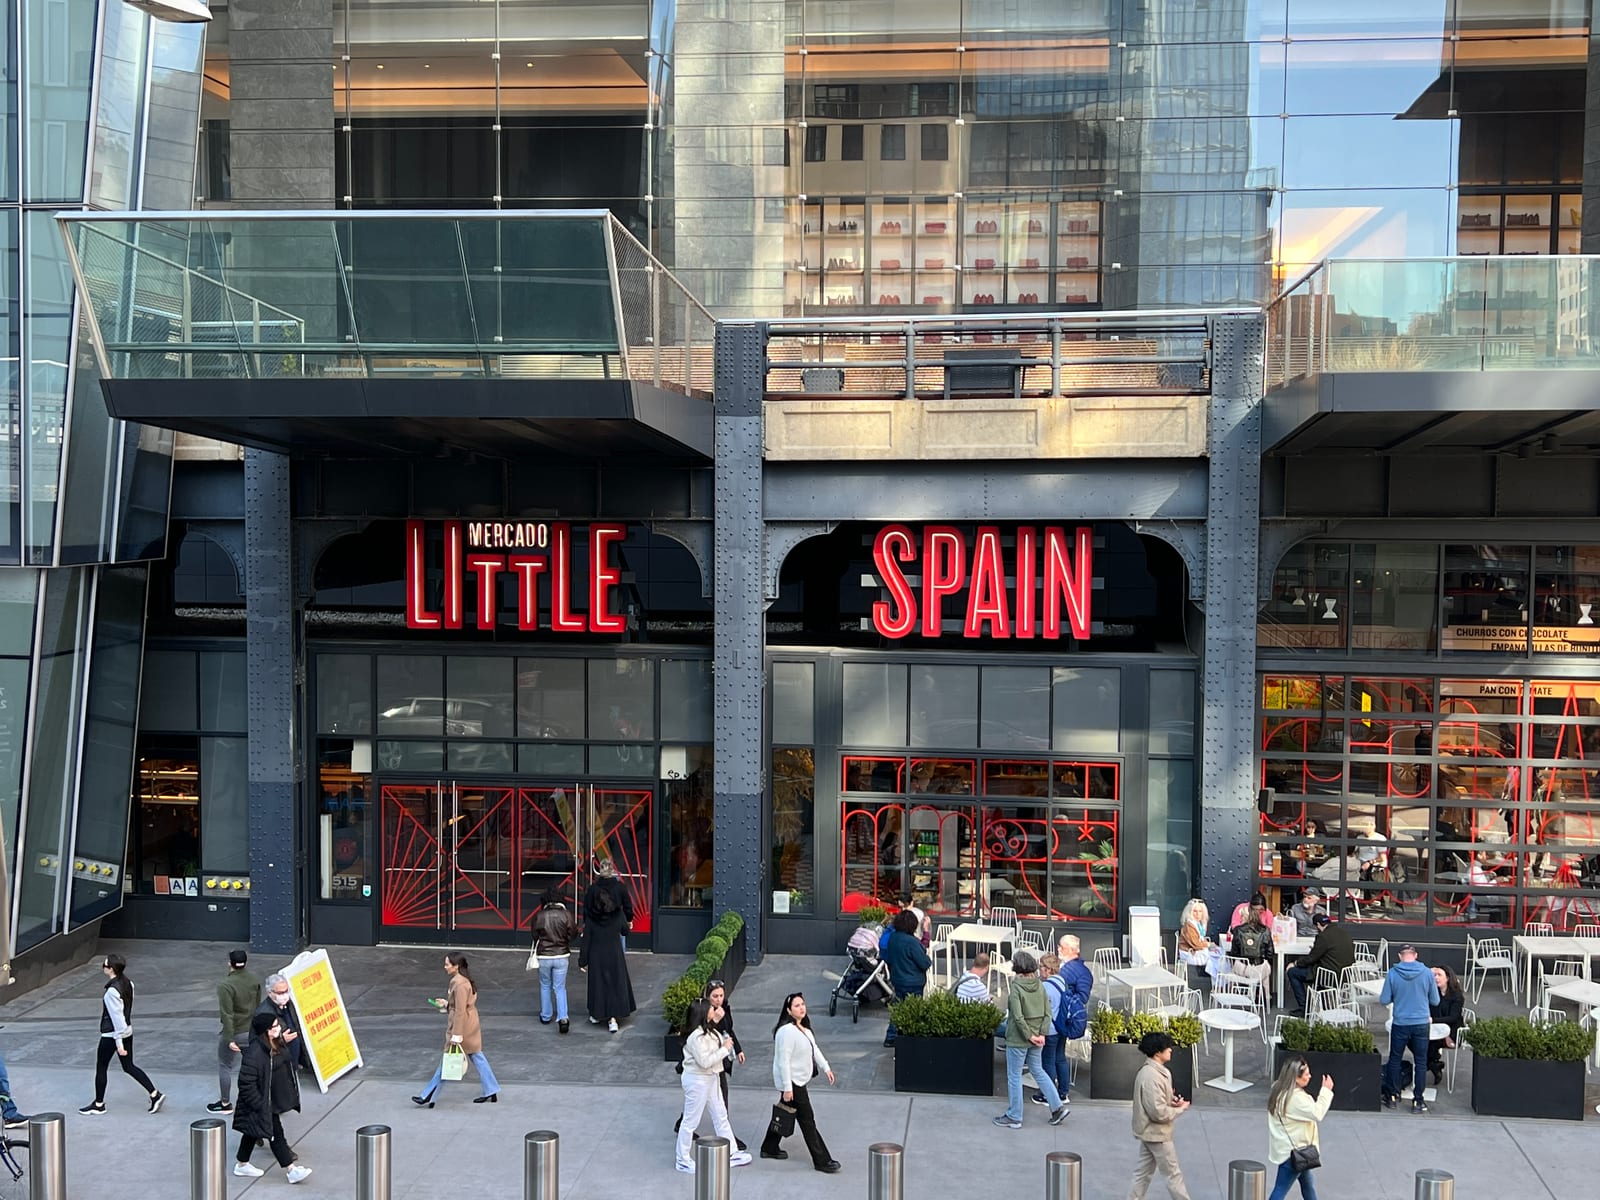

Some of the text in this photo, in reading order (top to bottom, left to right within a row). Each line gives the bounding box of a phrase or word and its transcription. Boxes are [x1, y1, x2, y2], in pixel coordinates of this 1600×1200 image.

[468, 522, 549, 548] MERCADO
[406, 519, 627, 633] LITTLE
[872, 523, 1092, 641] SPAIN
[1456, 628, 1497, 637] CHURROS
[1499, 628, 1516, 638] CON
[1480, 686, 1496, 694] PAN
[1498, 686, 1516, 695] CON
[173, 880, 182, 890] A
[333, 876, 357, 886] 515
[305, 1006, 324, 1025] SPANISH
[310, 1025, 317, 1036] IS
[317, 1020, 328, 1033] OPEN
[328, 1012, 340, 1025] EARLY
